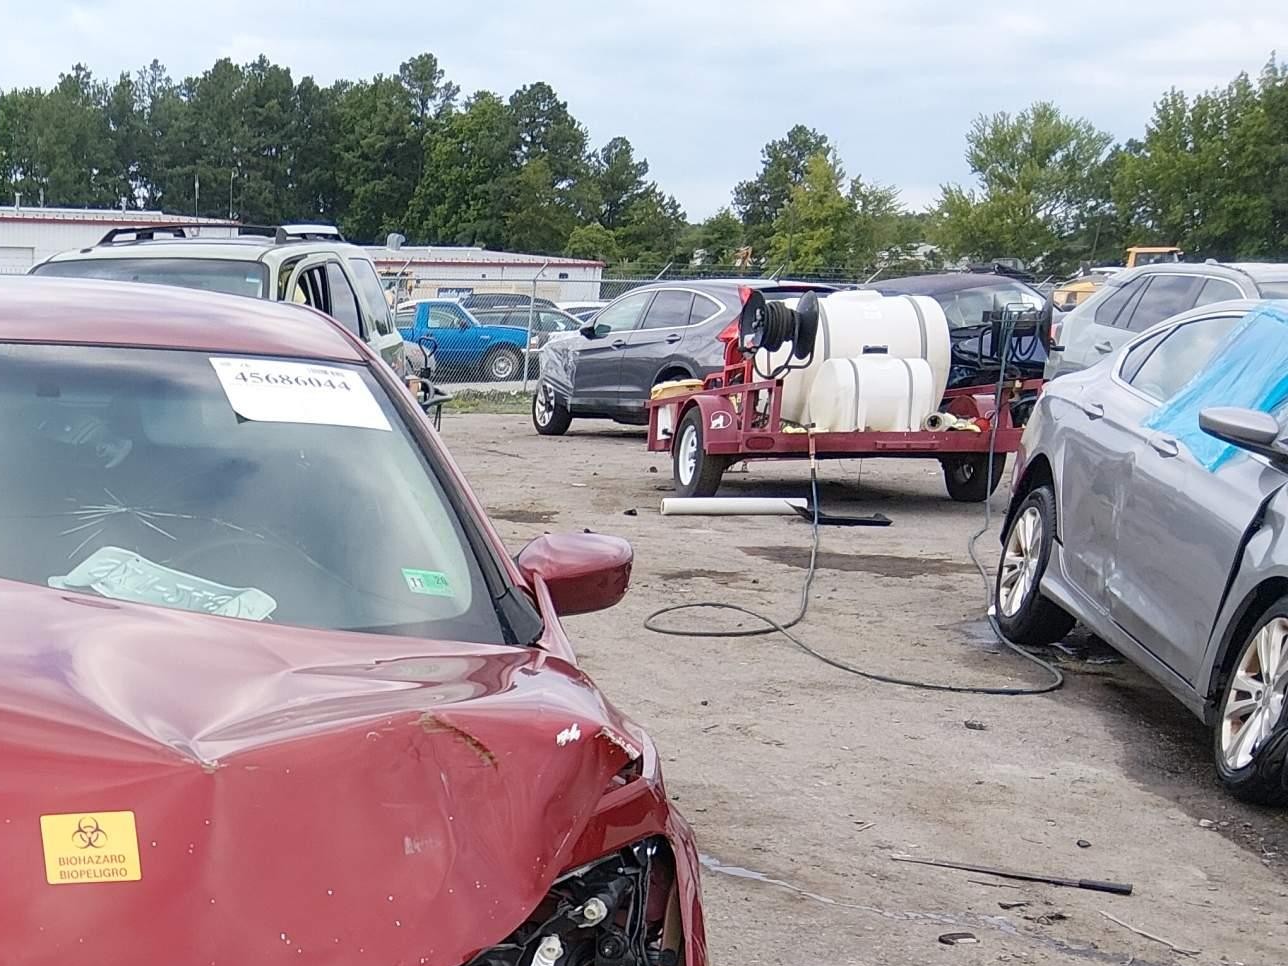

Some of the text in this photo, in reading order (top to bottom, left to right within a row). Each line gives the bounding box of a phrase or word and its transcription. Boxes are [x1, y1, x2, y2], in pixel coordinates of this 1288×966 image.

[235, 371, 352, 392] 45686044
[58, 854, 127, 867] BIOHAZARD
[59, 867, 128, 880] BIOPELIGRO
